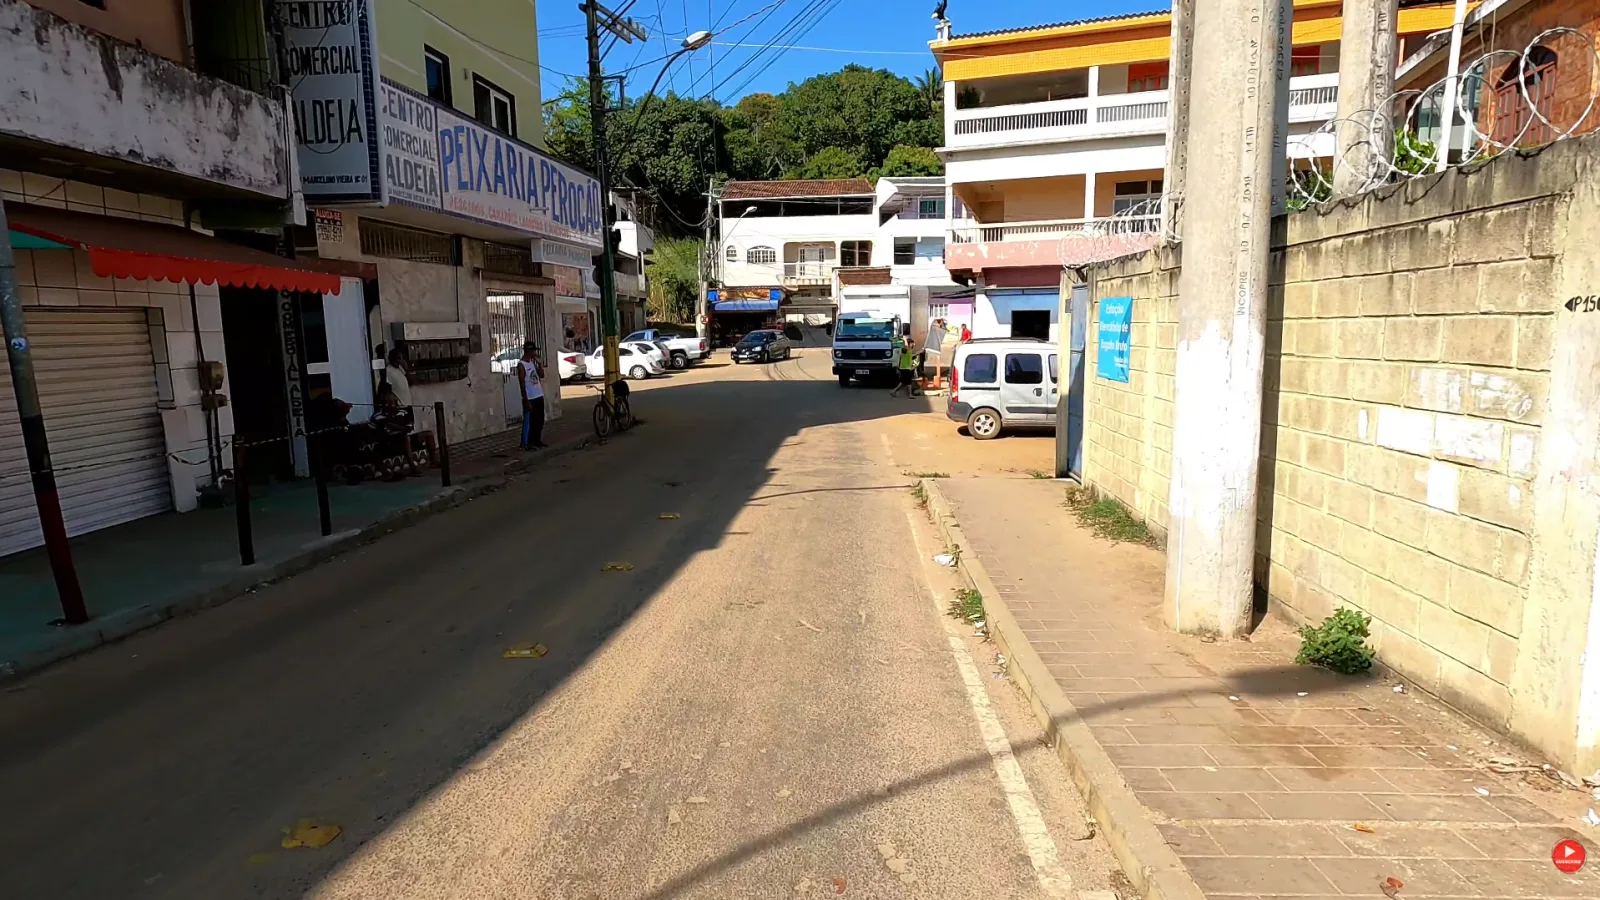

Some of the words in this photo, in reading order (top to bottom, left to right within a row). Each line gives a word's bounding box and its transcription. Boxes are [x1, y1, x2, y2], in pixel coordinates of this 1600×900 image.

[293, 98, 364, 145] ALDEIA
[386, 153, 439, 198] ALDEIA
[440, 125, 539, 207] PEIXARIA
[316, 217, 341, 226] SALA
[1235, 270, 1248, 316] INCOPRE
[1122, 321, 1129, 332] de
[289, 384, 305, 437] ALDEIA
